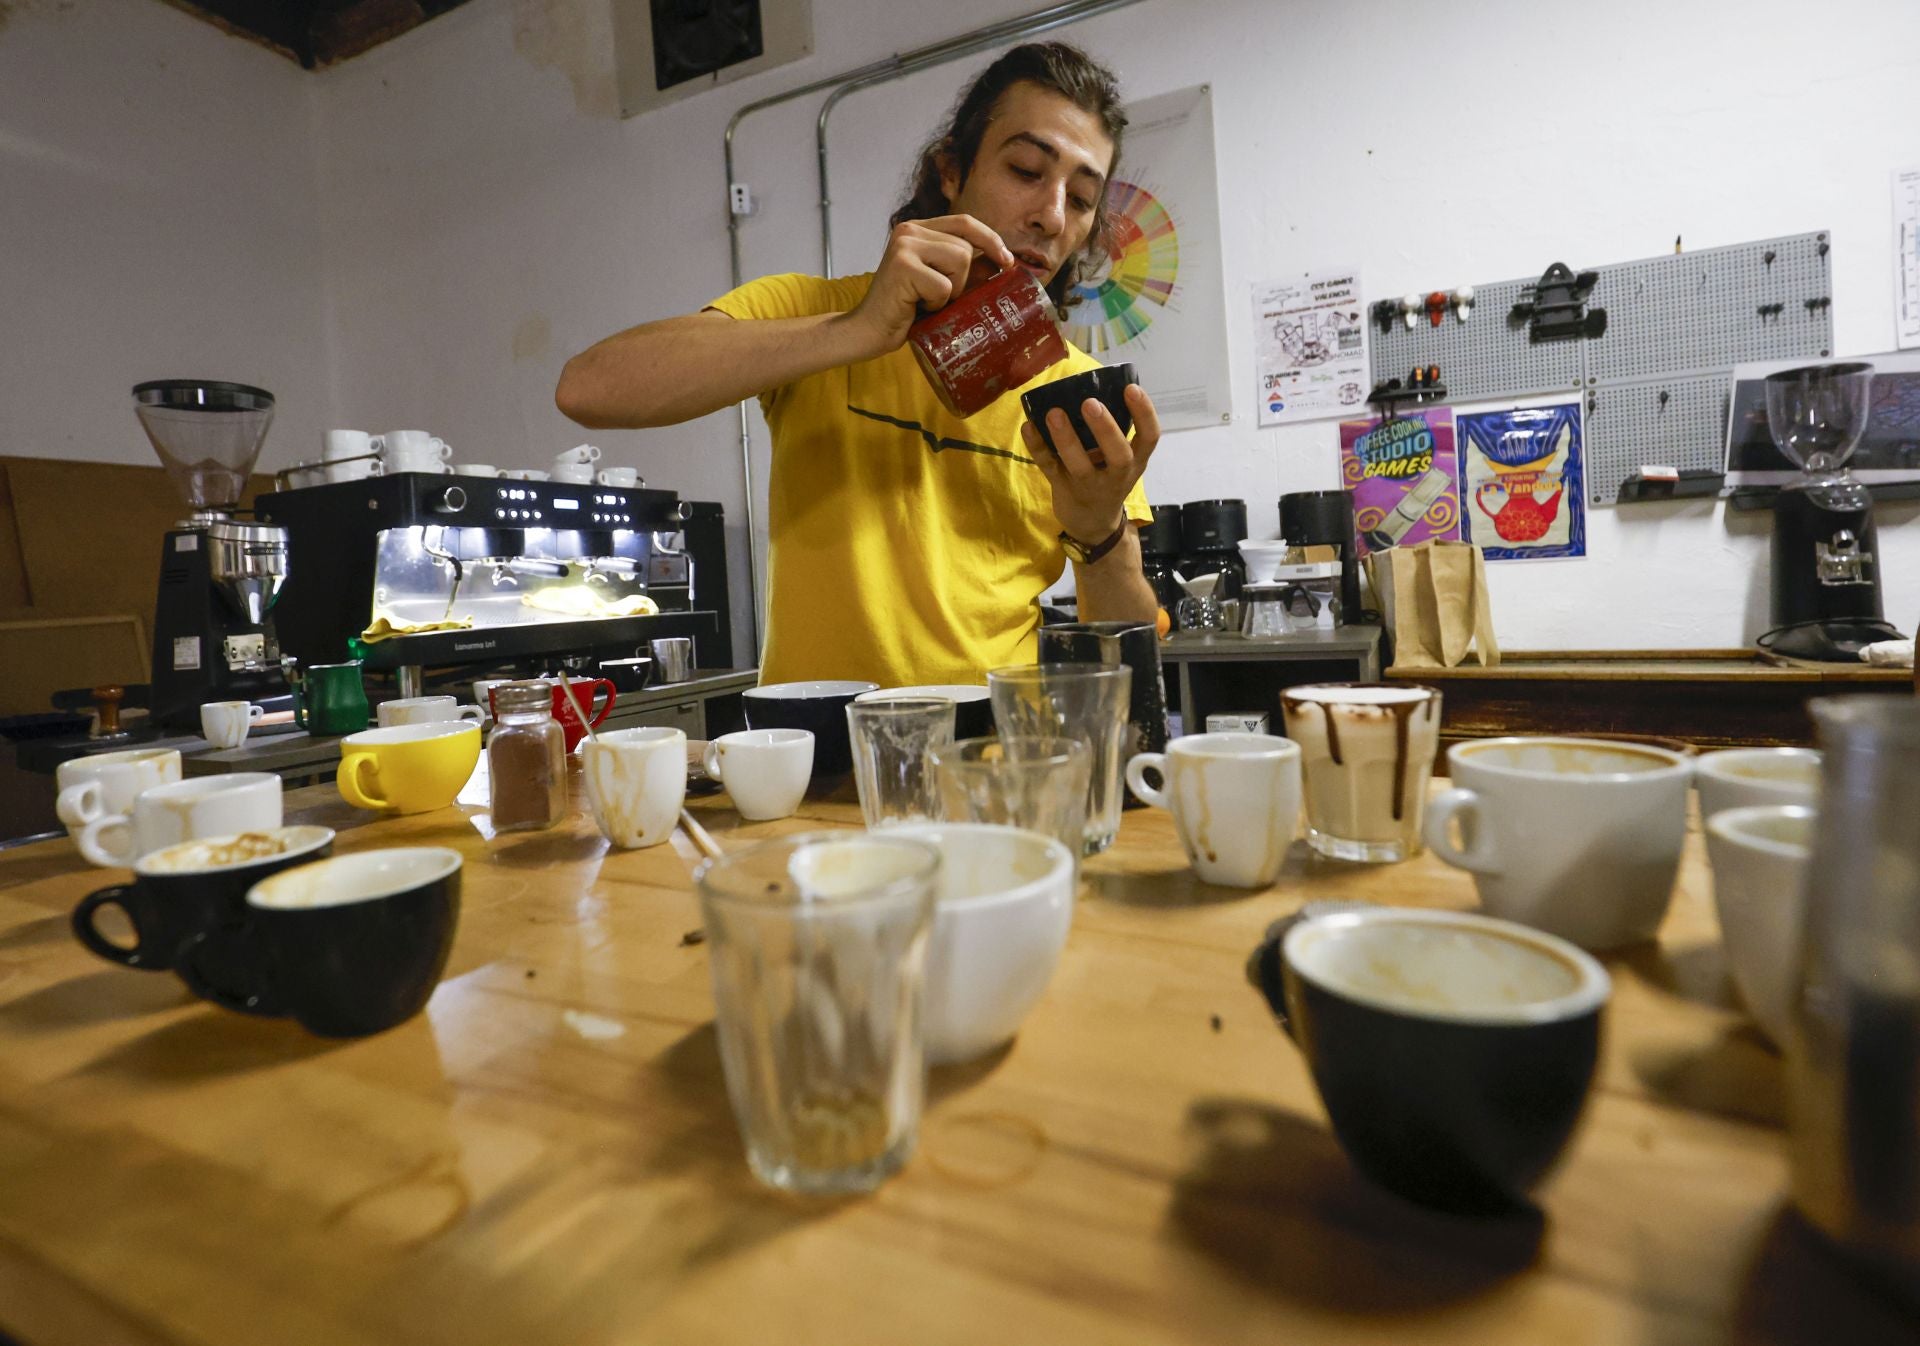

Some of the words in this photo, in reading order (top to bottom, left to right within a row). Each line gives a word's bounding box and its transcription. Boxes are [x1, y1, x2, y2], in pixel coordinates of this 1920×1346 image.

[1314, 289, 1351, 301] VALENCIA
[982, 305, 1008, 341] CLASSIC
[1354, 426, 1392, 455] COFFEE
[1391, 415, 1427, 440] COOKING
[1361, 431, 1433, 466] STUDIO
[1363, 456, 1433, 478] GAMES
